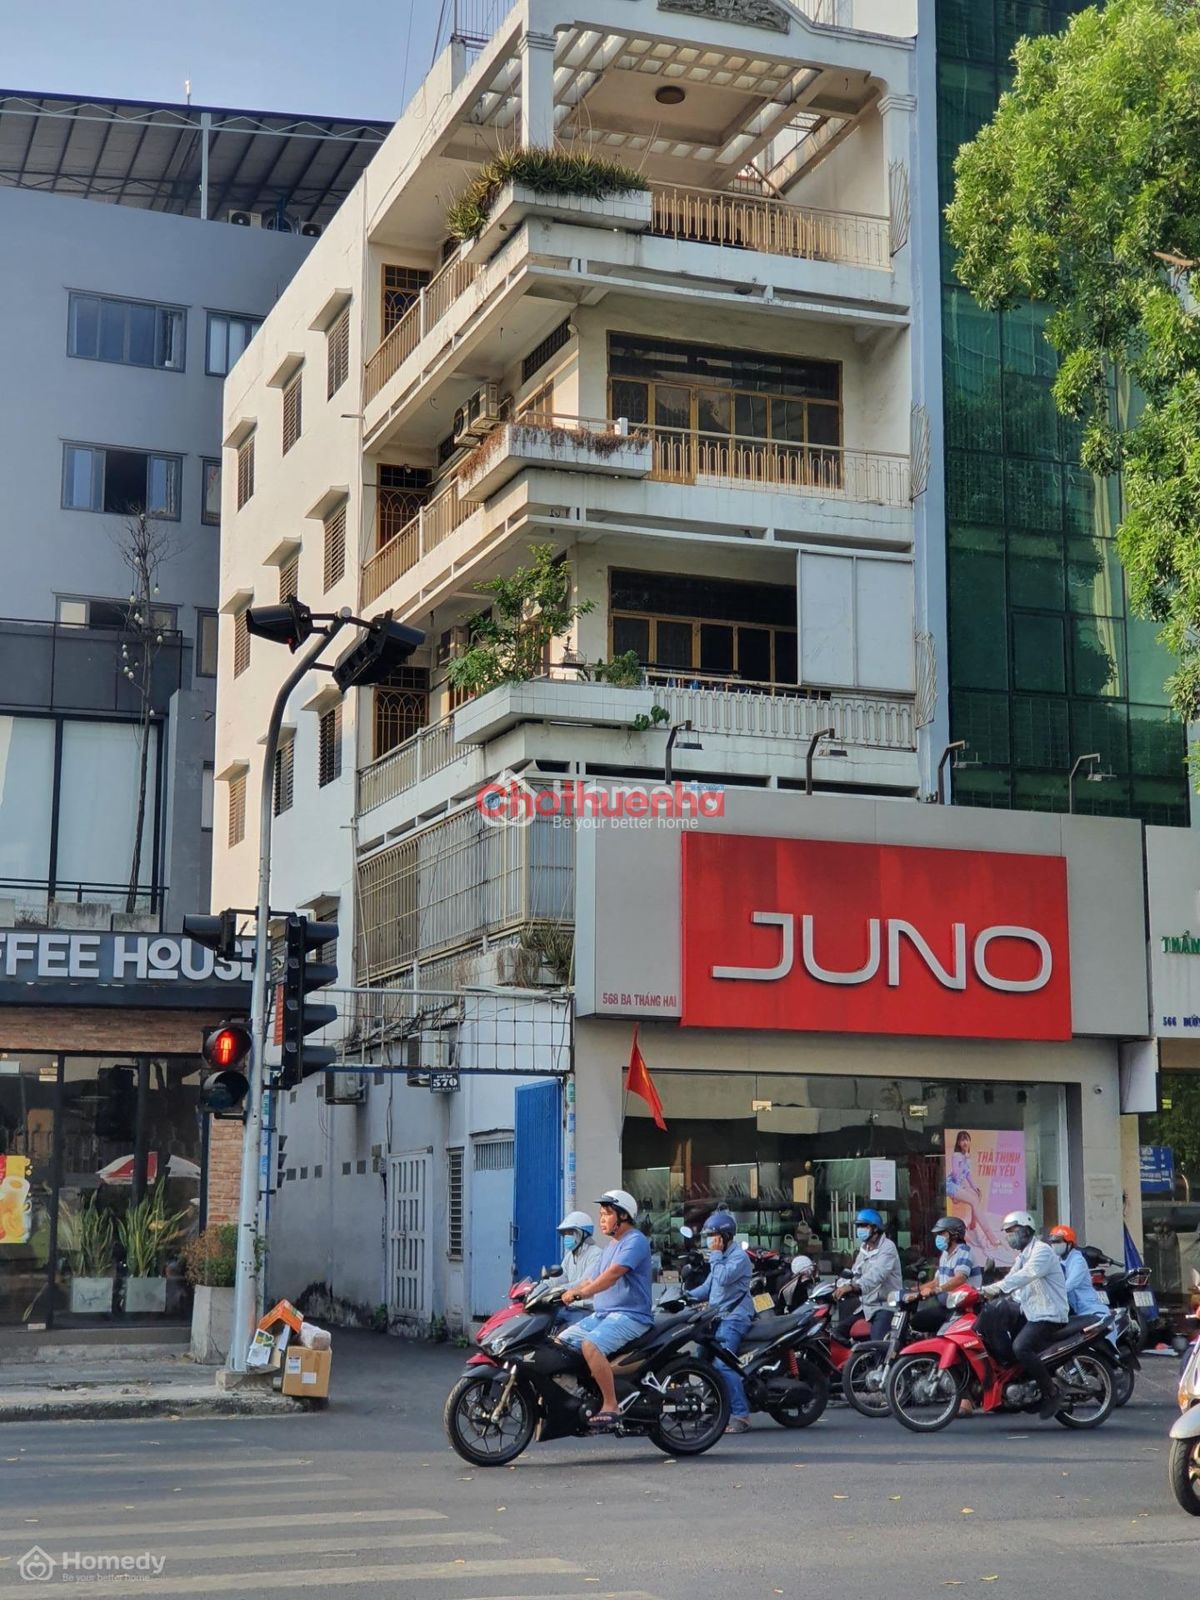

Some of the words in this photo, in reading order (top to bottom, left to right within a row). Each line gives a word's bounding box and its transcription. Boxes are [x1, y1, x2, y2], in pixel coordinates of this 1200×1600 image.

[0, 932, 100, 977] FEE
[712, 911, 1052, 992] JUNO
[602, 992, 619, 1005] 568
[621, 993, 632, 1006] BA
[634, 991, 661, 1007] THÁNG
[663, 995, 677, 1008] HAI
[433, 1078, 457, 1087] 570
